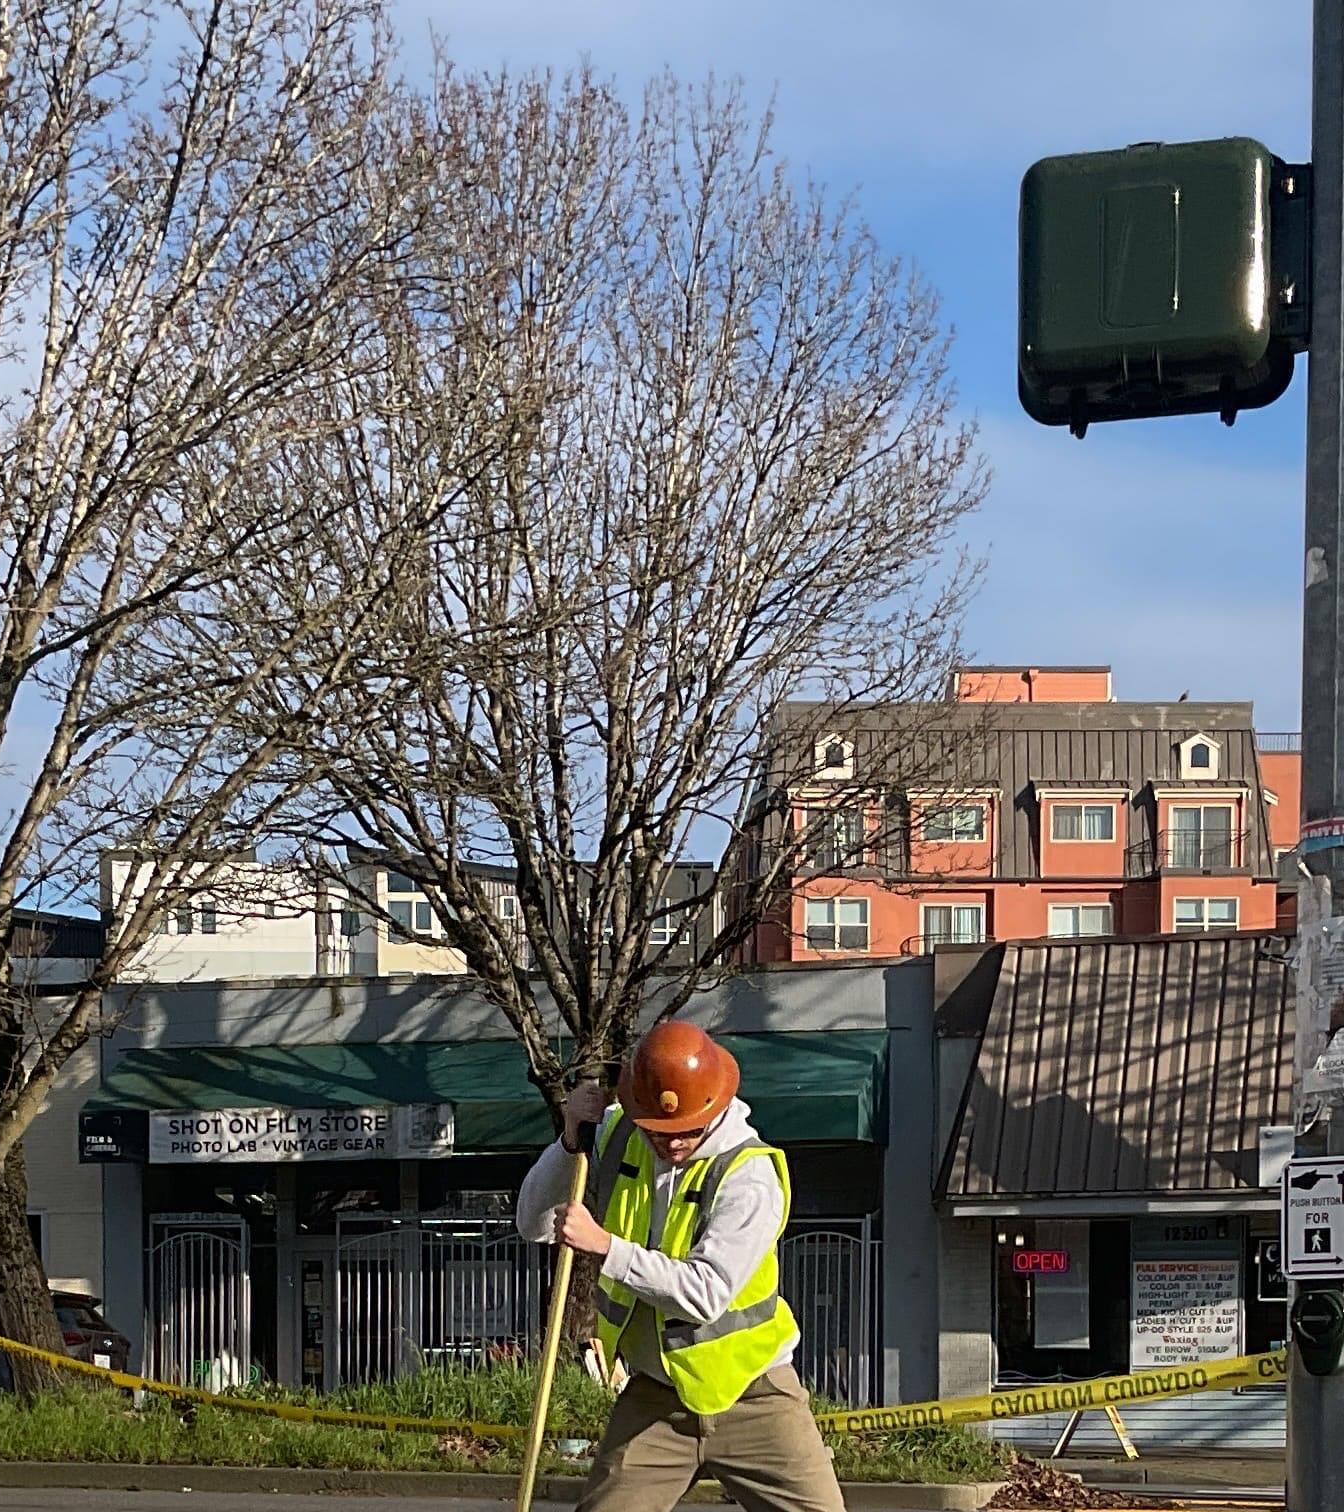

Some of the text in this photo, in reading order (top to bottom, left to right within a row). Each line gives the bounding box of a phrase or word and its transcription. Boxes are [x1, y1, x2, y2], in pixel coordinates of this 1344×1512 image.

[168, 1116, 387, 1135] SHOT ON FILM STORE
[171, 1138, 385, 1154] PHOTO LAB VINTAGE GEAR
[1290, 1197, 1342, 1208] PUSH BUTTON
[1306, 1212, 1329, 1224] FOR
[1017, 1254, 1065, 1270] OPEN
[1159, 1264, 1199, 1272] SERVICE
[1136, 1317, 1166, 1325] LADIES
[1167, 1326, 1194, 1334] STYLE
[1146, 1346, 1163, 1354] EYE
[1164, 1346, 1191, 1354] BROW
[1154, 1355, 1177, 1363] BODY
